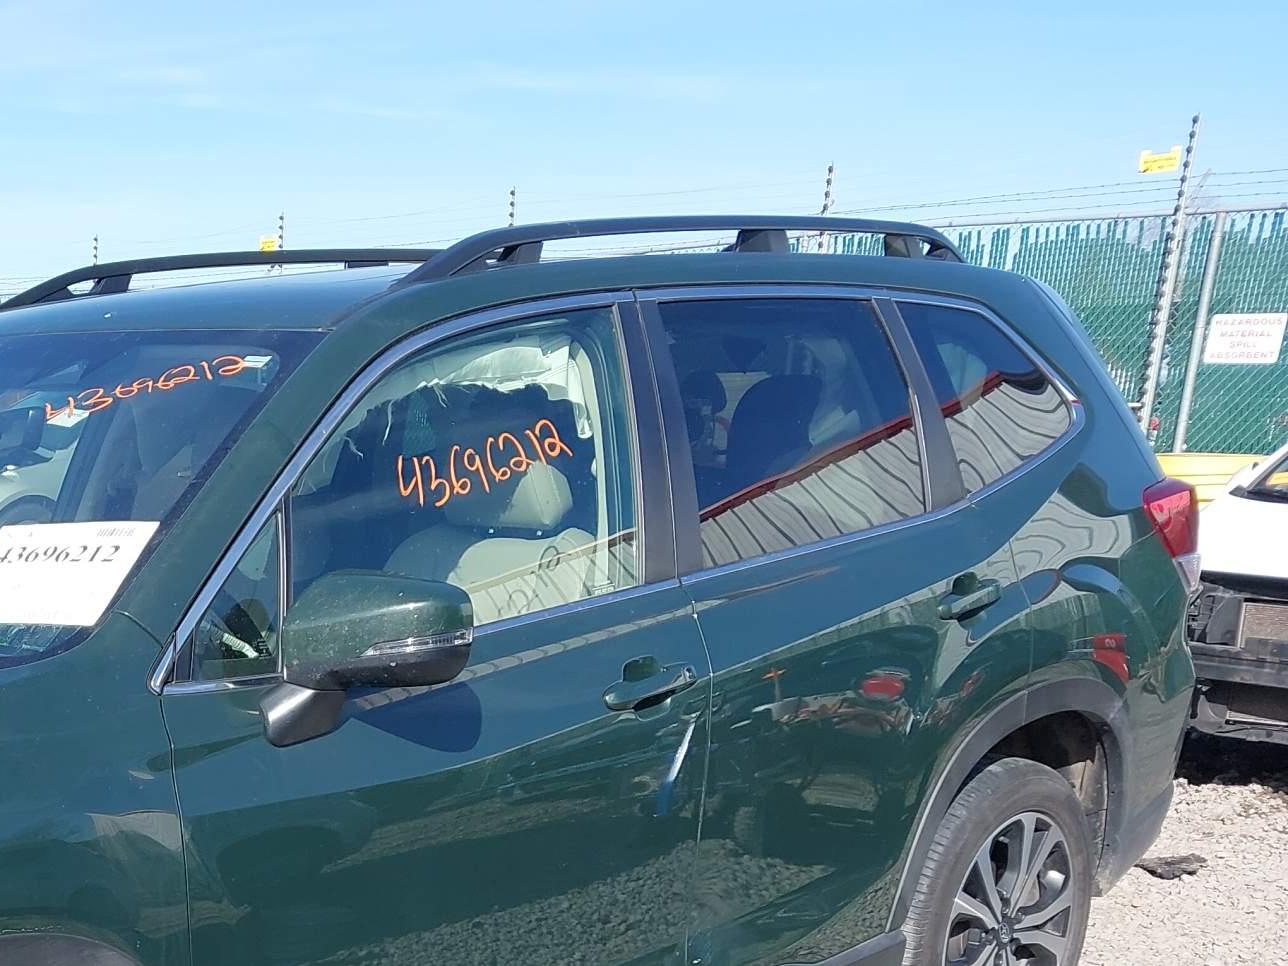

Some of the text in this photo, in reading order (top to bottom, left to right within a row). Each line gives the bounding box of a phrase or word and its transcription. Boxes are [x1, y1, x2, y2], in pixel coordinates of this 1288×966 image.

[1215, 317, 1283, 326] HAZARDOUS
[1219, 329, 1272, 337] MATERIAL
[1229, 341, 1256, 349] SPILL
[1209, 351, 1276, 359] ABSORBENT
[45, 355, 248, 422] 43696212
[396, 419, 574, 508] 43696212
